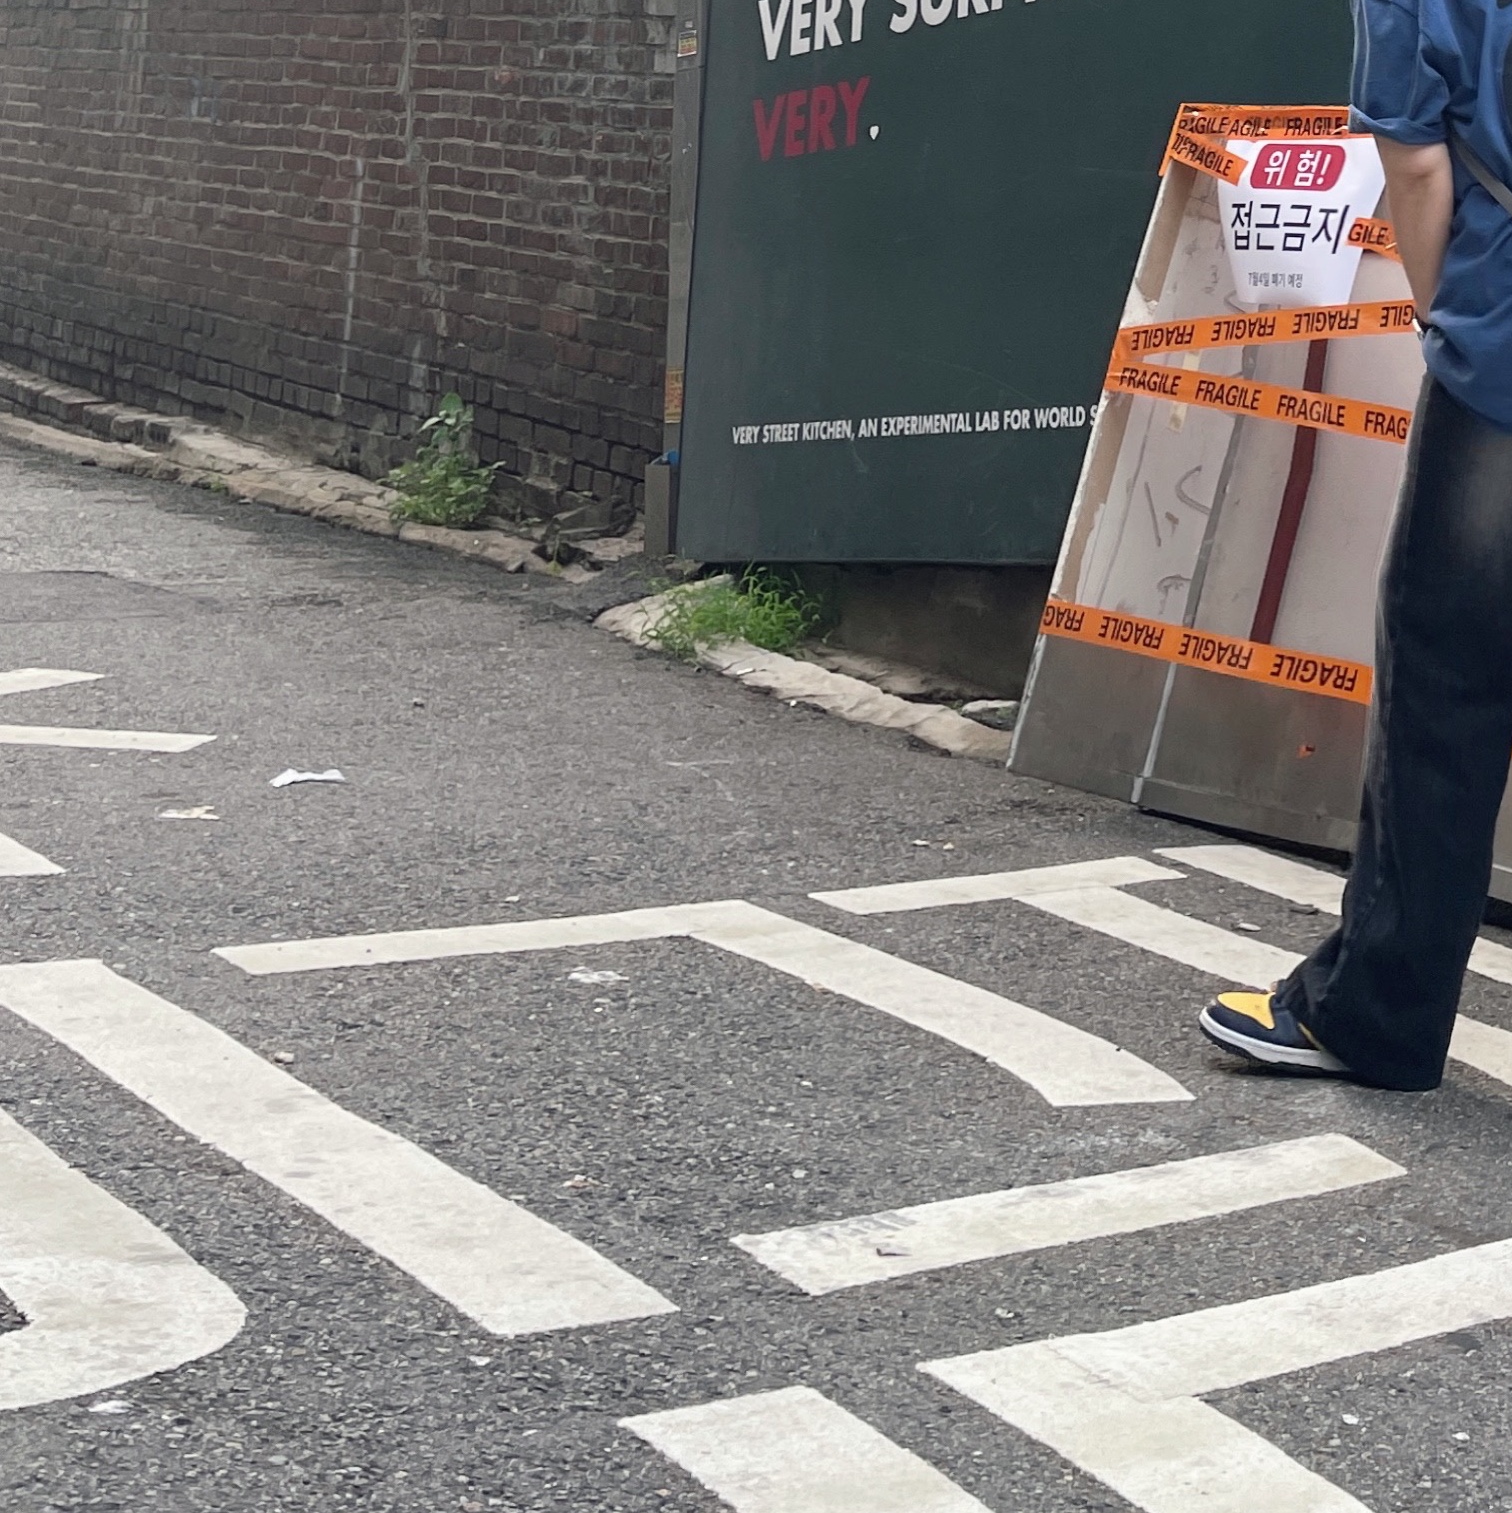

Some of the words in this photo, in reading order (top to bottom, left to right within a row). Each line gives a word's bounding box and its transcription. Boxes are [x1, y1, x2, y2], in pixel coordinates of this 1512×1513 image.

[752, 76, 880, 161] VERY.
[1231, 200, 1350, 255] 접근금지
[1131, 324, 1195, 351] FRAGILE
[1211, 316, 1276, 341] FRAGILE
[1292, 308, 1361, 335] FRAGILE
[732, 426, 760, 445] VERY
[763, 423, 799, 443] STREET
[802, 418, 856, 442] KITCHEN,
[858, 418, 878, 438] AN
[881, 412, 972, 437] EXPERIMENTAL
[975, 412, 1000, 433] LAB
[1003, 409, 1030, 431] FOR
[1035, 405, 1086, 429] WORLD
[1119, 367, 1182, 396] FRAGILE
[1195, 380, 1262, 410] FRAGILE
[1276, 394, 1346, 427] FRAGILE
[1098, 615, 1165, 650] FRAGILE
[1179, 634, 1254, 670] FRAGILE
[1271, 653, 1359, 692] FRAGILE
